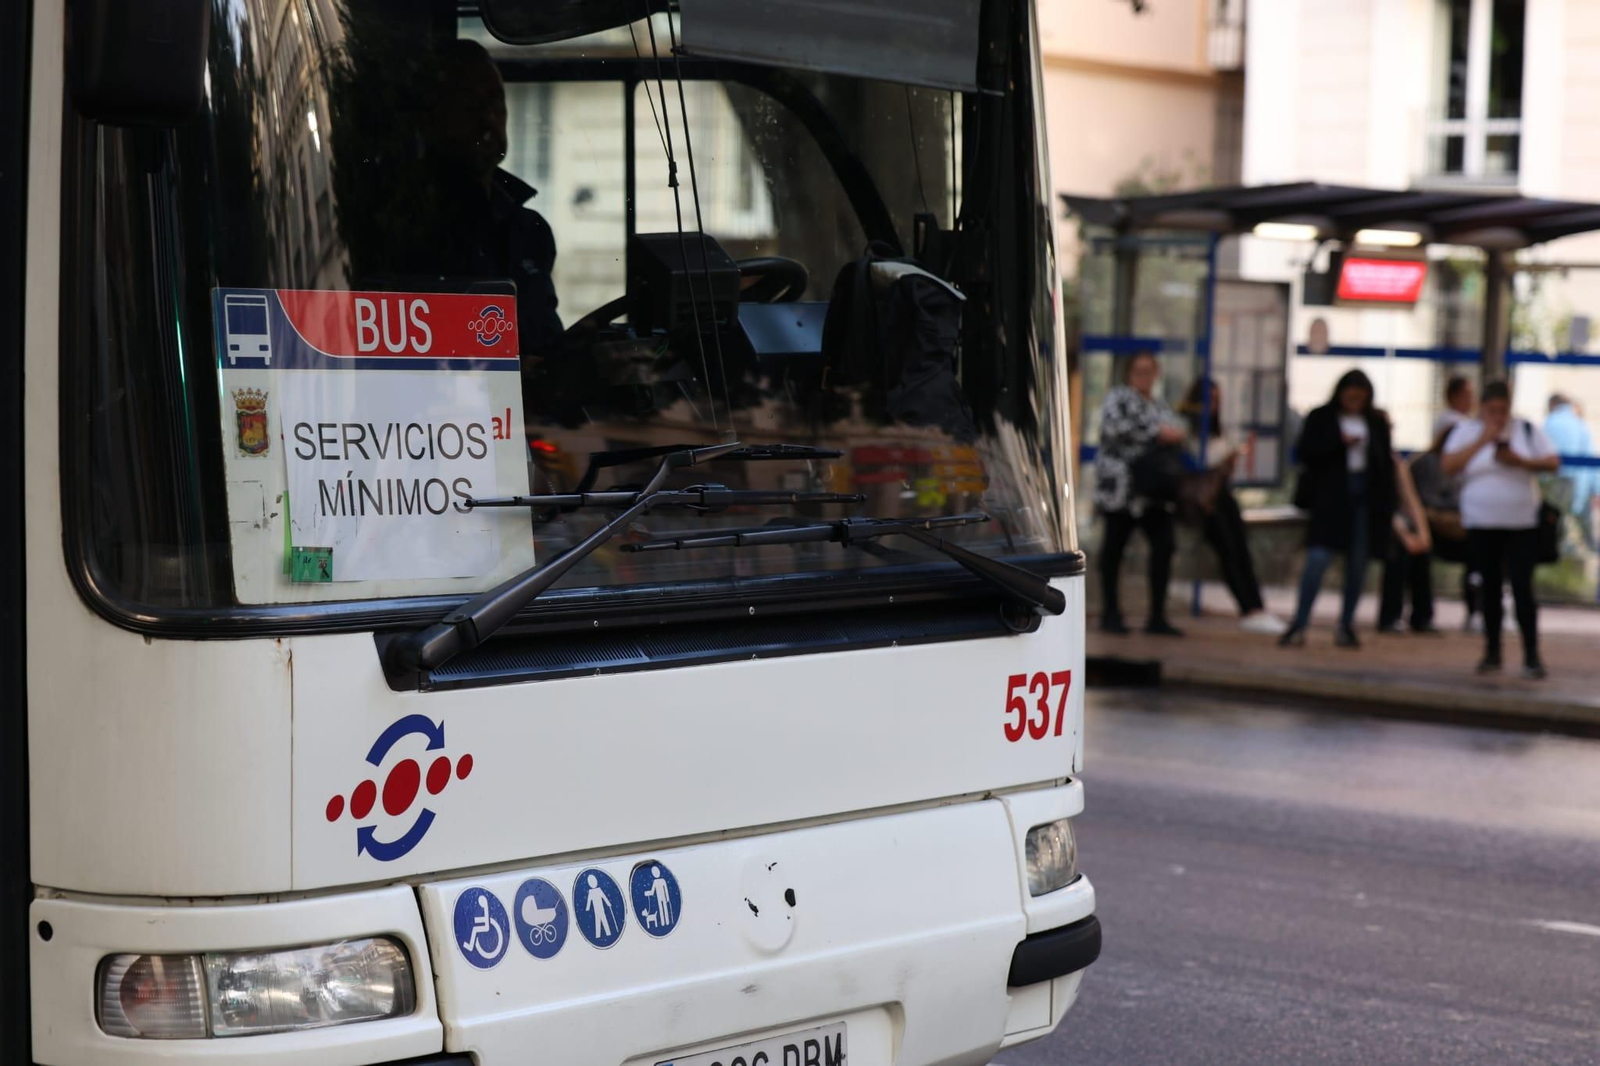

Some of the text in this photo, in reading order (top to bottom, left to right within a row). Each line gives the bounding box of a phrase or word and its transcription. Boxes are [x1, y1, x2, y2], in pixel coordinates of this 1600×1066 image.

[355, 298, 432, 353] BUS
[294, 422, 487, 460] SERVICIOS
[318, 470, 473, 516] MÍNIMOS
[1004, 669, 1071, 742] 537
